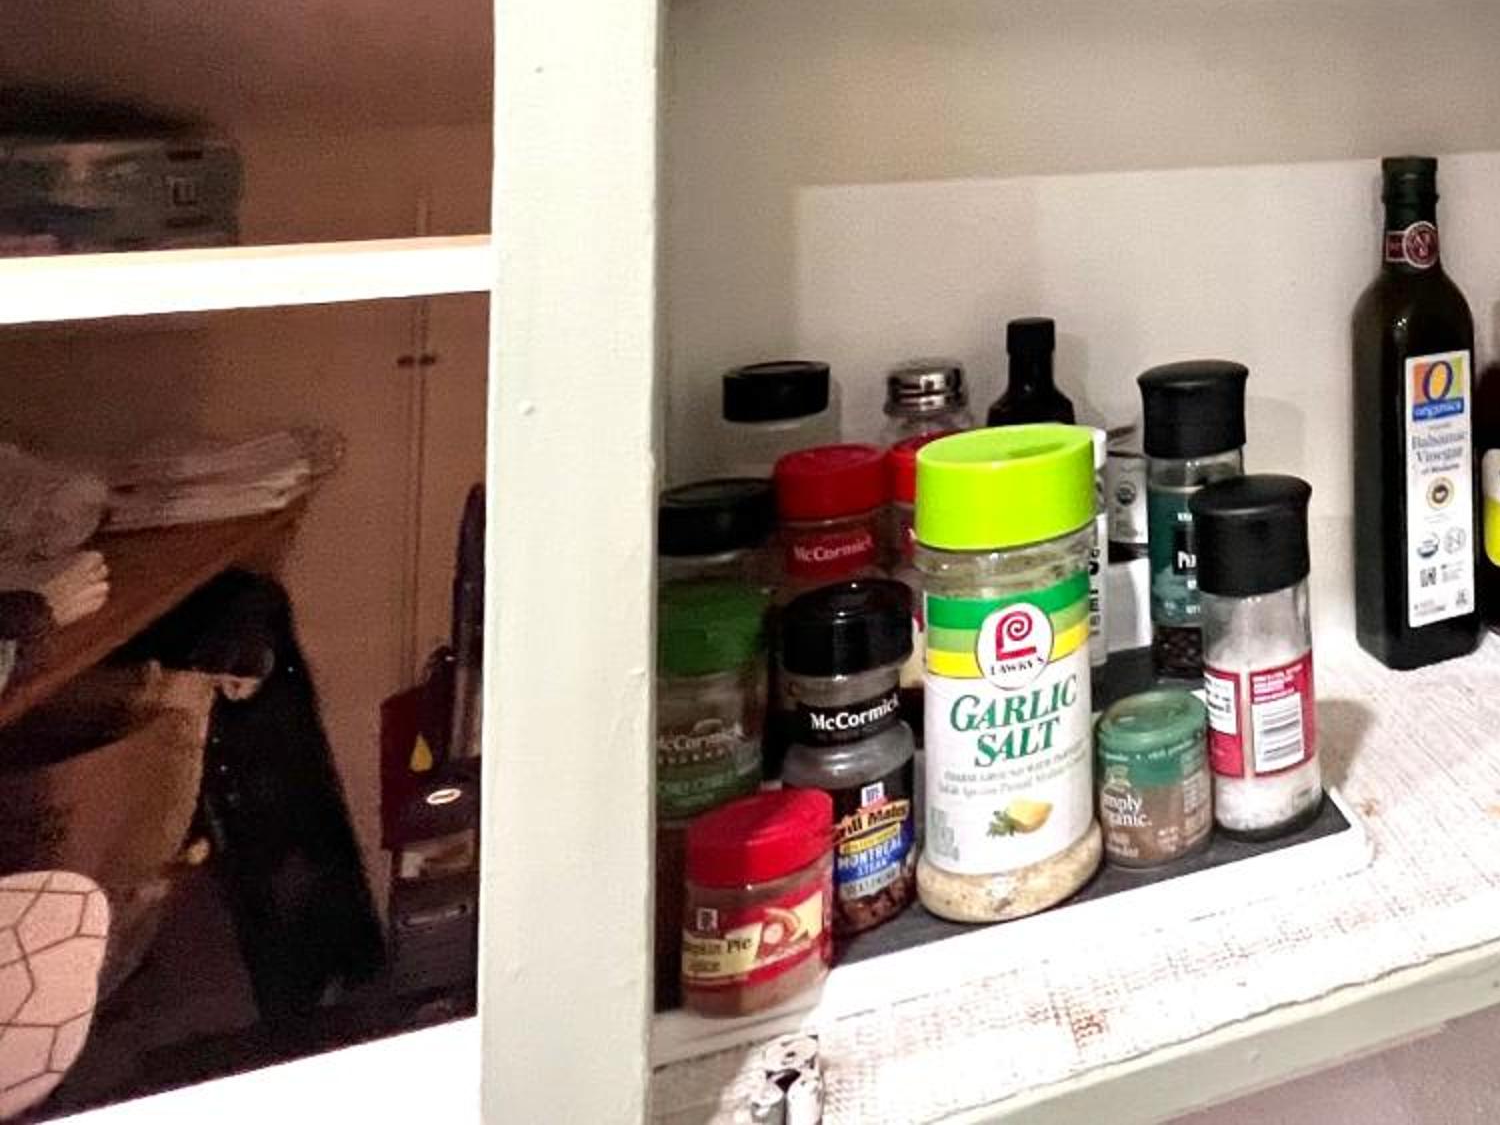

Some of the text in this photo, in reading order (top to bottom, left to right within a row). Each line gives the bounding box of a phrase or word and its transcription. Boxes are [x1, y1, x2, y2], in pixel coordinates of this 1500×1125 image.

[794, 535, 873, 562] McCormick
[810, 693, 900, 731] McCormick
[950, 674, 1078, 733] GARLIC
[974, 717, 1061, 769] SALT
